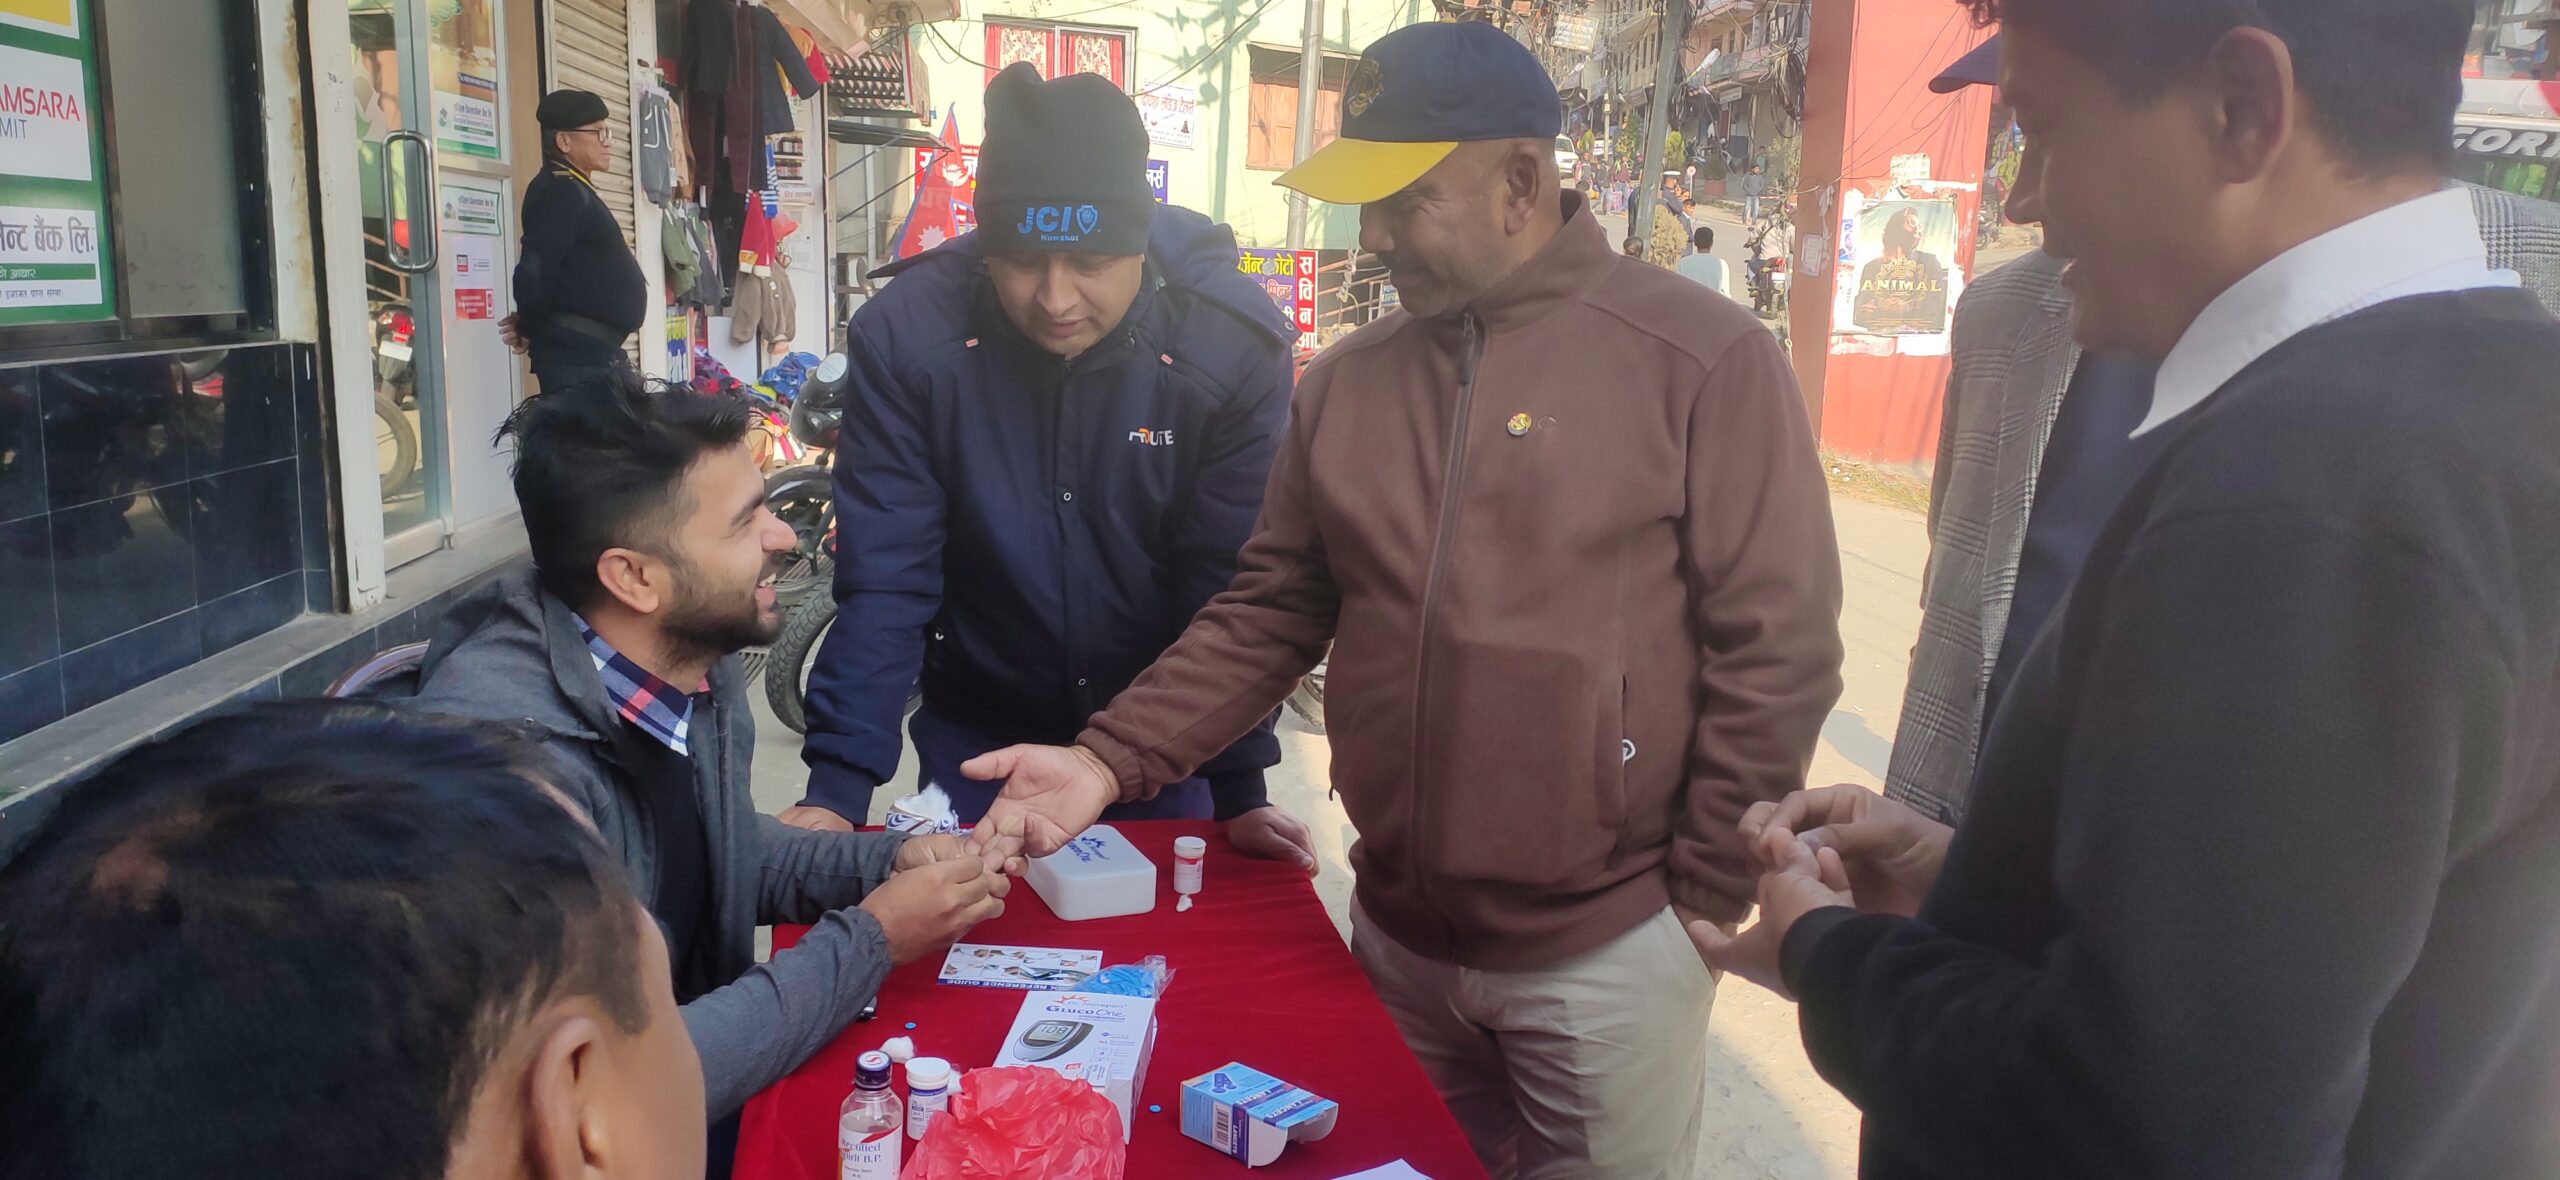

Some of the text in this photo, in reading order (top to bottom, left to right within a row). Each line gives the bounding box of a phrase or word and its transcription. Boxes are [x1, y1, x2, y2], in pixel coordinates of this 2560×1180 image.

[1017, 206, 1072, 234] JCI
[33, 214, 63, 252] बैंक
[67, 216, 94, 254] लि.
[1040, 234, 1079, 242] Nuwakot
[1861, 279, 1942, 292] ANIMAL
[982, 981, 1047, 990] REFERENCE
[1041, 1025, 1068, 1034] 108
[841, 1138, 881, 1153] Rectified
